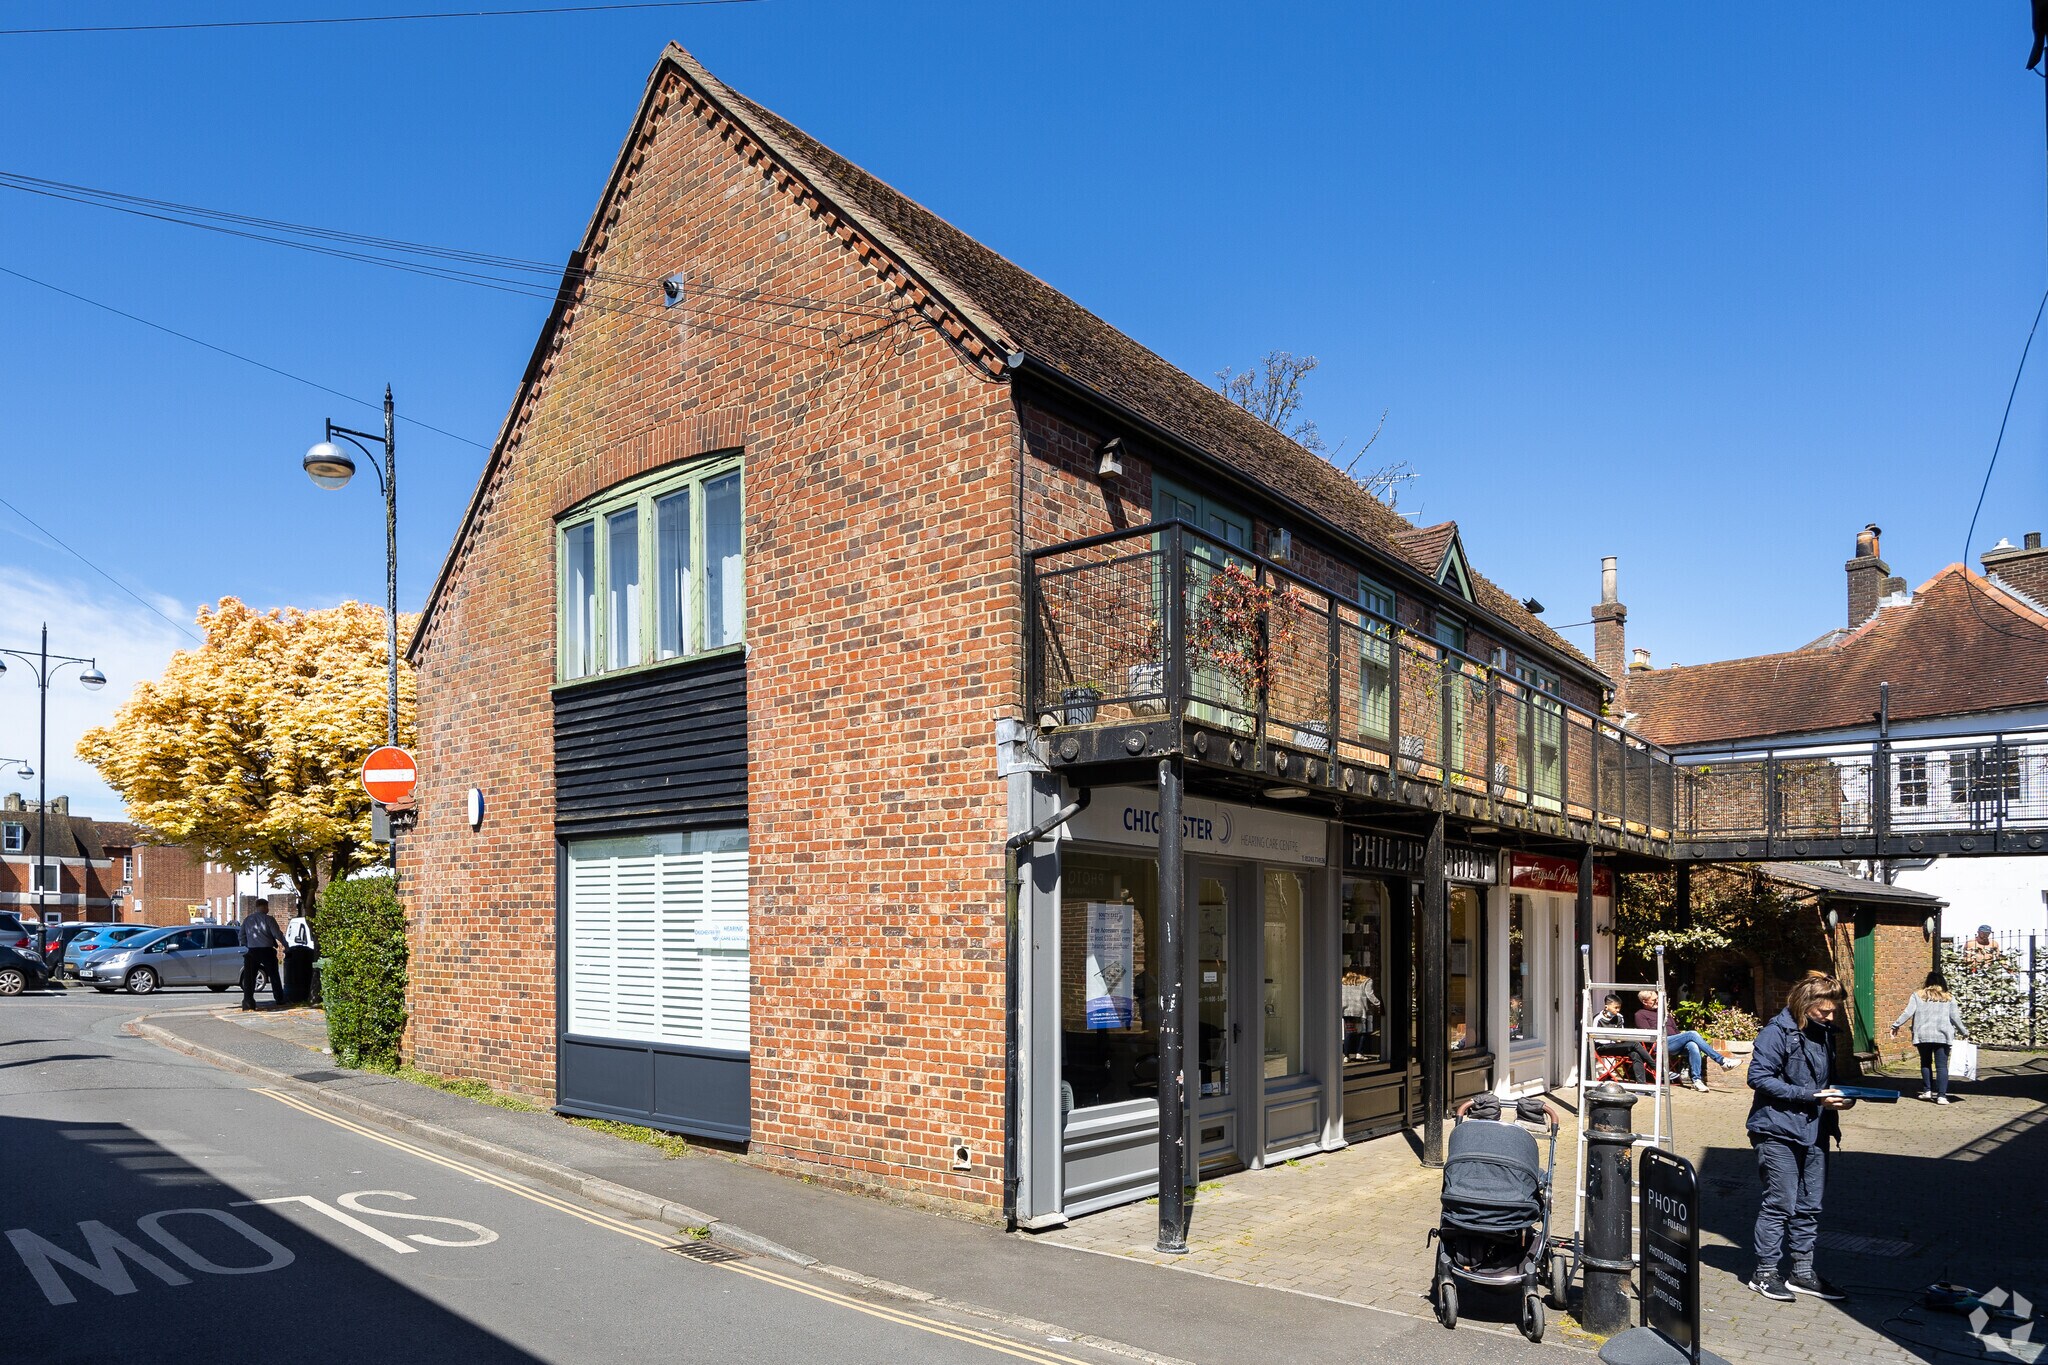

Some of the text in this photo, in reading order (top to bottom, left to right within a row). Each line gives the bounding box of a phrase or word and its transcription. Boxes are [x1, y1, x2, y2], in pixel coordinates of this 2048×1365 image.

[1123, 807, 1213, 841] CHICSTER
[1241, 834, 1299, 852] HEARING CARE CENTRE
[1531, 862, 1558, 885] Crystal
[1648, 1188, 1687, 1221] PHOTO
[4, 1190, 500, 1306] SLOW
[1649, 1244, 1687, 1274] PHOTO PRINTING
[1655, 1267, 1680, 1290] PASSPORTS
[1653, 1285, 1682, 1311] PHOTO GIFTS
